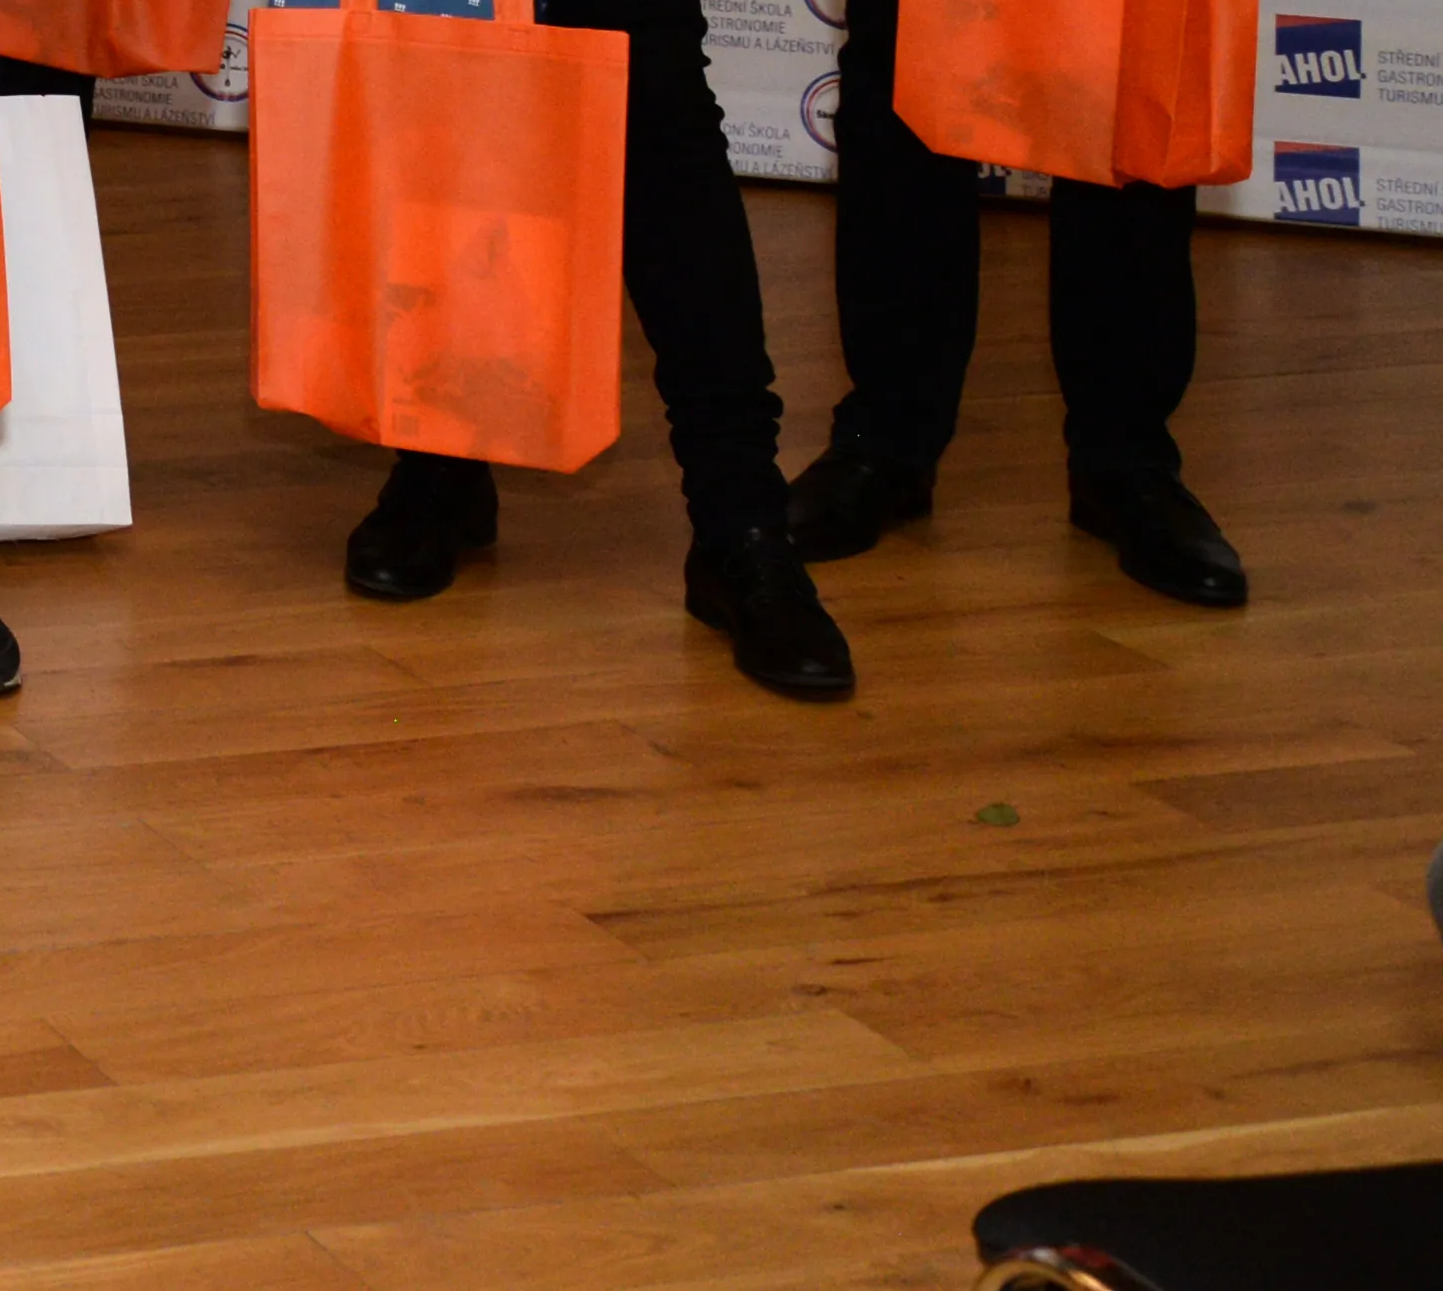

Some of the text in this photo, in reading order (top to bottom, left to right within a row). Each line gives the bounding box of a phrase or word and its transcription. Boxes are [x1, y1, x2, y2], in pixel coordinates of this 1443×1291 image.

[1275, 49, 1366, 86] AHOL
[1377, 49, 1441, 67] STŘEDNÍ
[1377, 70, 1443, 87] GASTRON
[1273, 176, 1365, 214] AHOL
